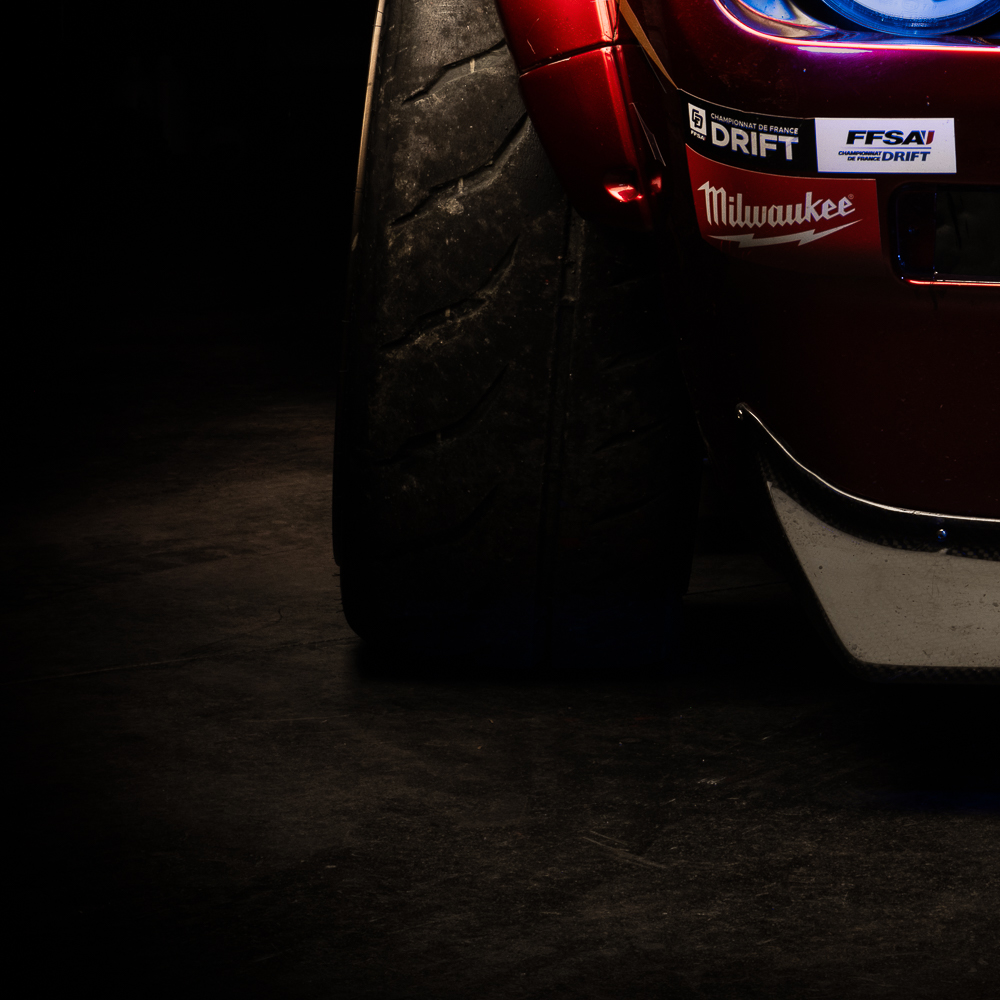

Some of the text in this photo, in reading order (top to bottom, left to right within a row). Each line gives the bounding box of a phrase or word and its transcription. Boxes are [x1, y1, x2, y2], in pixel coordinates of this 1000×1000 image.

[710, 112, 799, 135] CHAMPIONNAT DE FRANCE
[711, 121, 799, 161] DRIFT
[846, 130, 925, 145] FFSA
[881, 151, 931, 162] DRIFT
[697, 180, 857, 229] Milwaukee
